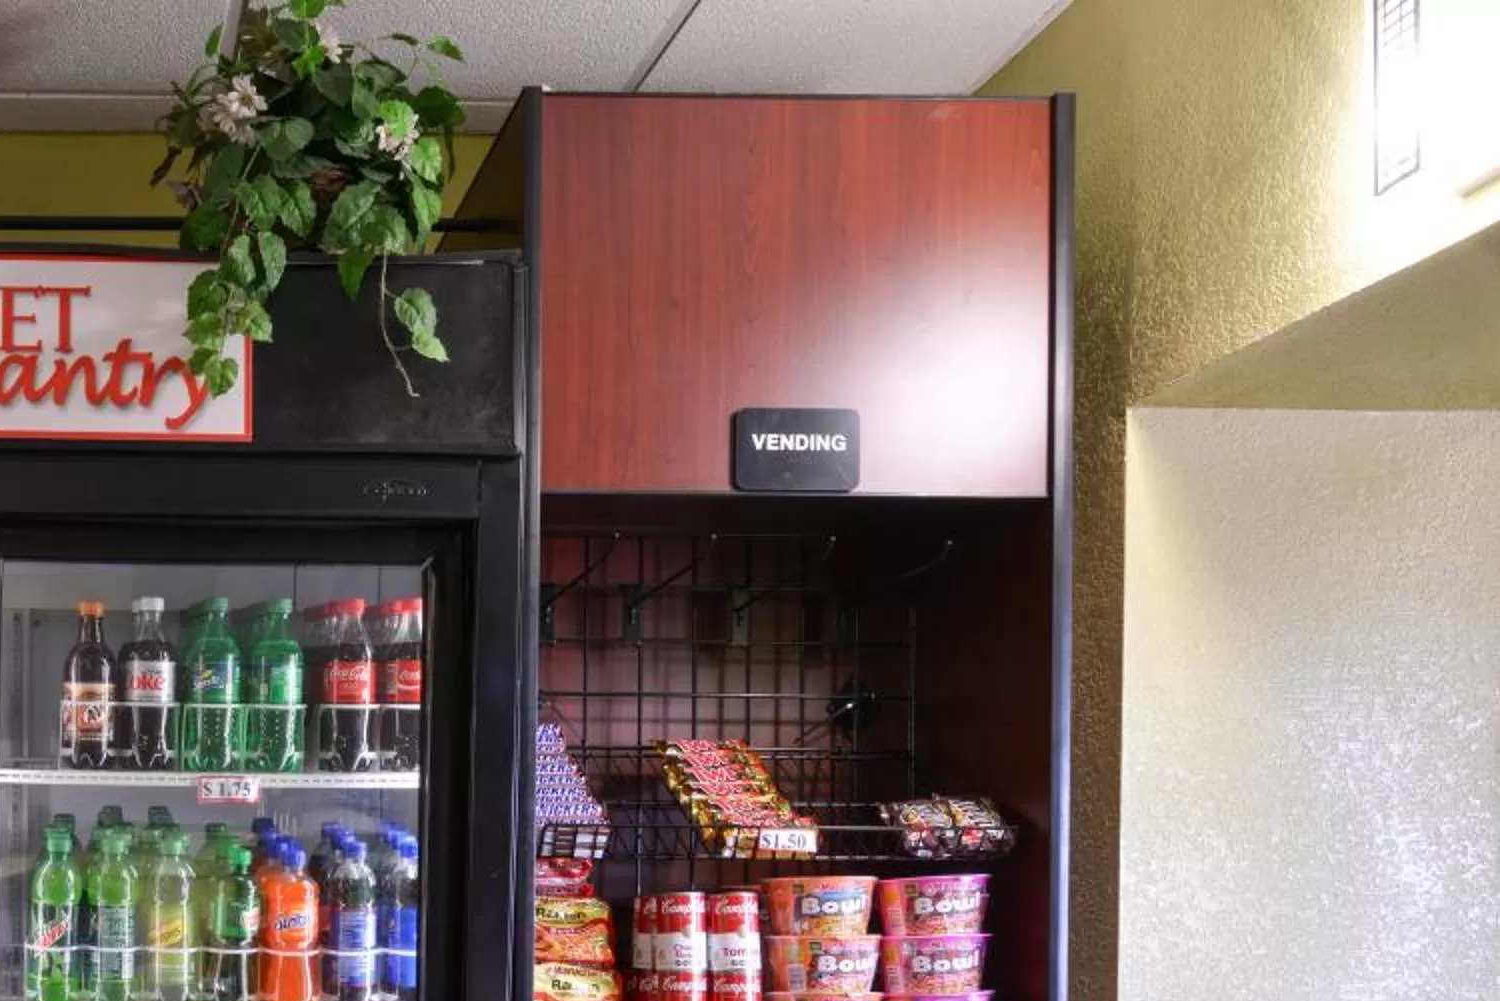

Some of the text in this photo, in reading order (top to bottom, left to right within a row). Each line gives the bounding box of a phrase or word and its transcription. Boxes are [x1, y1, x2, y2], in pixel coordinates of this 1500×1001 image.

[752, 433, 848, 451] VENDING
[762, 833, 807, 850] $1.50
[914, 891, 980, 915] Bowl
[911, 950, 979, 974] Bowl
